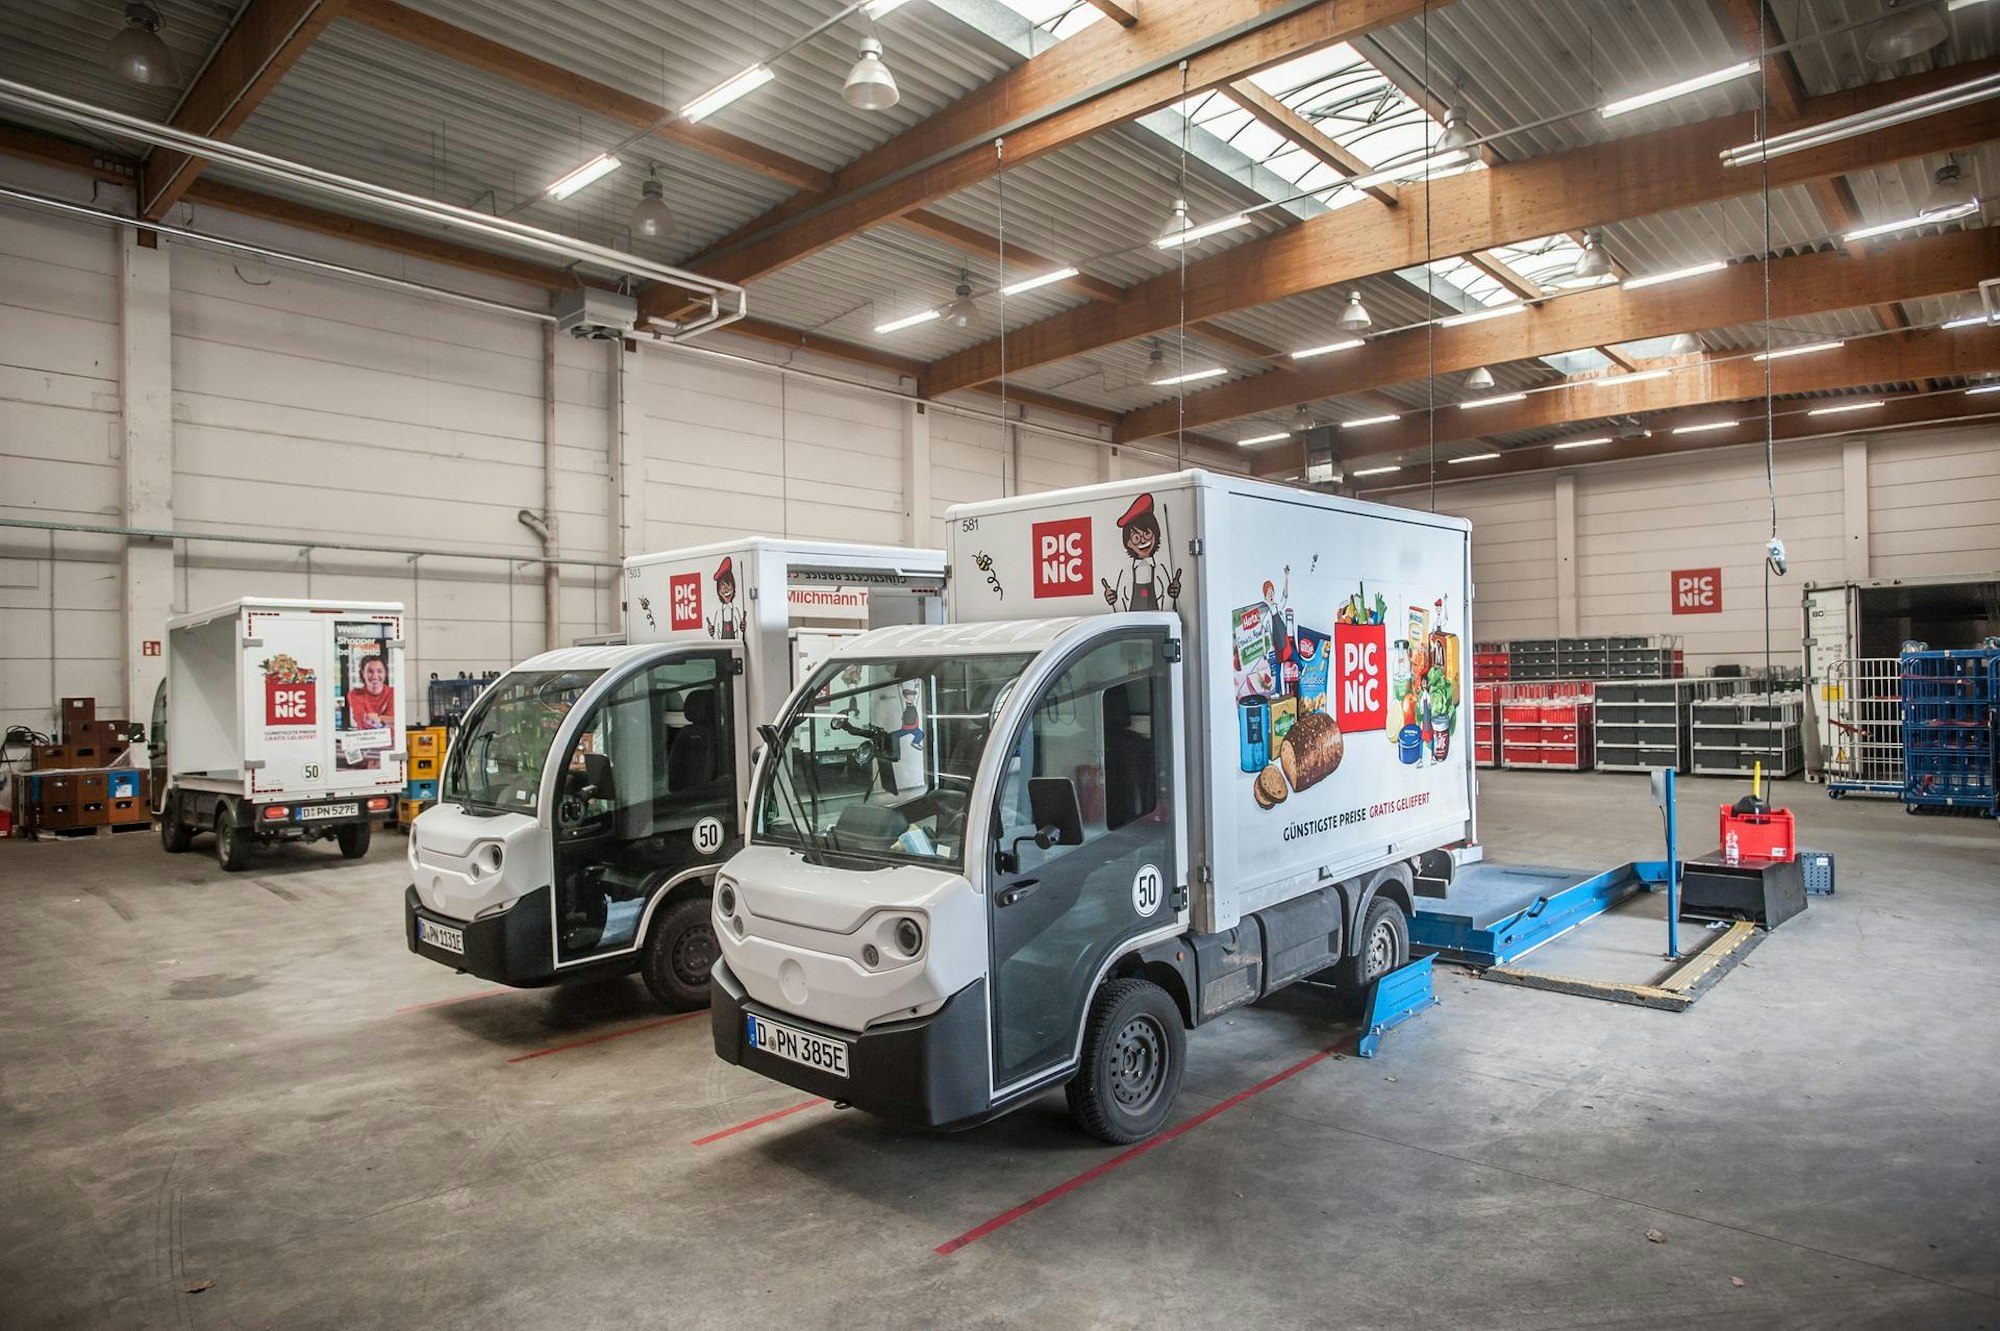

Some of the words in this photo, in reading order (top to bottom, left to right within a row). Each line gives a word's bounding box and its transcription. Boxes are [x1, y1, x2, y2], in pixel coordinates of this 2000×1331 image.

[962, 518, 979, 532] 581
[1041, 532, 1082, 559] PIC
[629, 568, 641, 579] 503
[1679, 576, 1714, 592] PIC
[675, 583, 697, 602] PIC
[1344, 642, 1379, 676] PIC
[275, 690, 307, 704] PIC
[305, 765, 319, 778] 50
[1283, 815, 1337, 841] GÜNSTIGSTE
[1340, 808, 1366, 826] PREISE
[1369, 801, 1394, 818] GRATIS
[1396, 792, 1430, 811] GELIEFERT
[700, 824, 717, 847] 50
[1139, 874, 1156, 908] 50
[757, 1022, 766, 1046] D
[776, 1028, 797, 1058] PN
[801, 1036, 845, 1073] 385E
